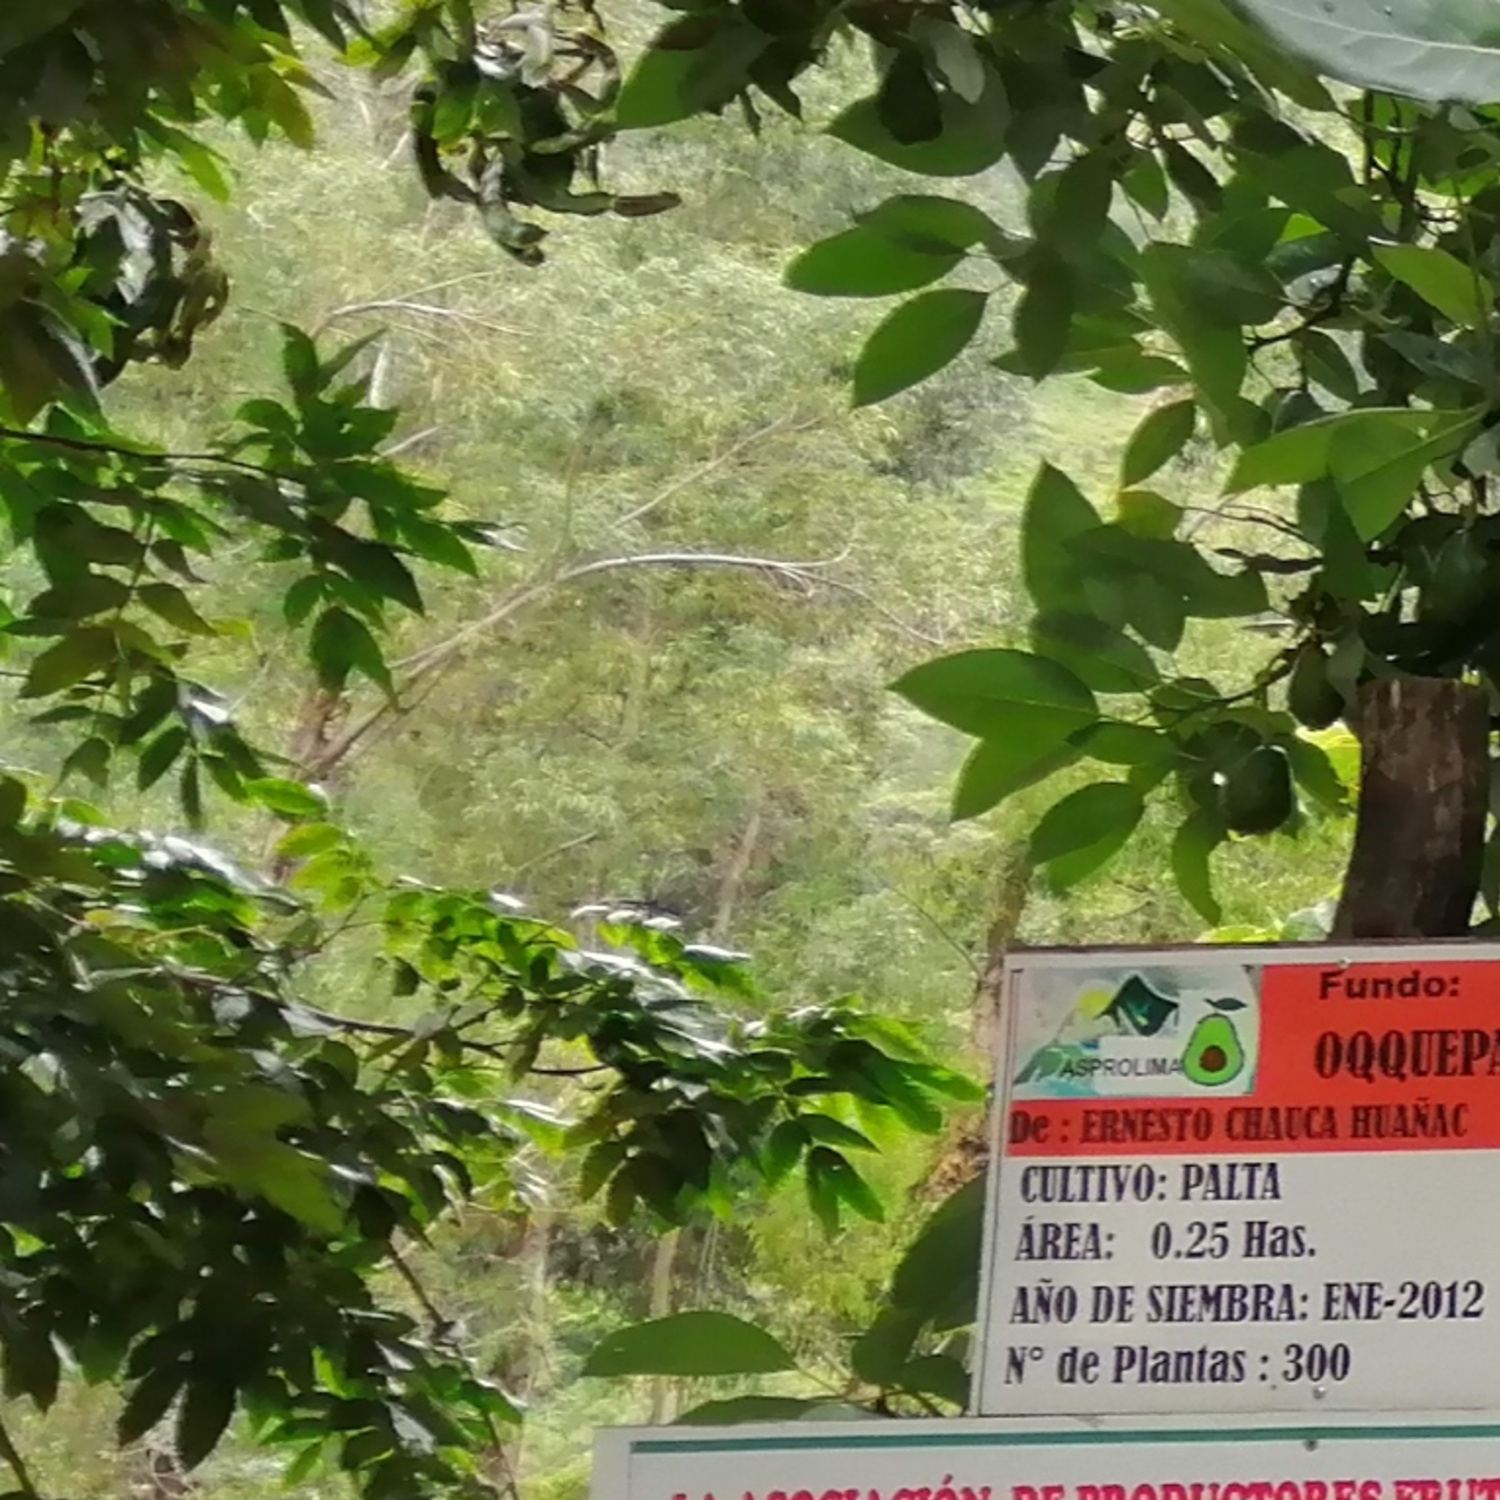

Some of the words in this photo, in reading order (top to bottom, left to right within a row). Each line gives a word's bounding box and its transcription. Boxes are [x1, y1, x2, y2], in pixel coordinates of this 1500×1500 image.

[1320, 969, 1459, 1000] Fundo:
[1058, 1057, 1184, 1078] ASPROLIMA
[1007, 1109, 1050, 1145] De
[1081, 1108, 1213, 1143] ERNESTO
[1225, 1105, 1338, 1142] CHAUCA
[1350, 1098, 1467, 1139] HUAÑAC
[1021, 1163, 1166, 1203] CULTIVO:
[1180, 1162, 1281, 1201] PALTA
[1015, 1215, 1113, 1261] ÁREA:
[1152, 1220, 1229, 1260] 0.25
[1242, 1220, 1315, 1259] Has.
[1011, 1279, 1077, 1324] AÑO
[1090, 1286, 1134, 1323] DE
[1147, 1283, 1308, 1323] SIEMBRA:
[1322, 1279, 1484, 1321] ENE-2012
[1058, 1346, 1099, 1385] de
[1112, 1345, 1245, 1384] Plantas
[1282, 1343, 1350, 1382] 300
